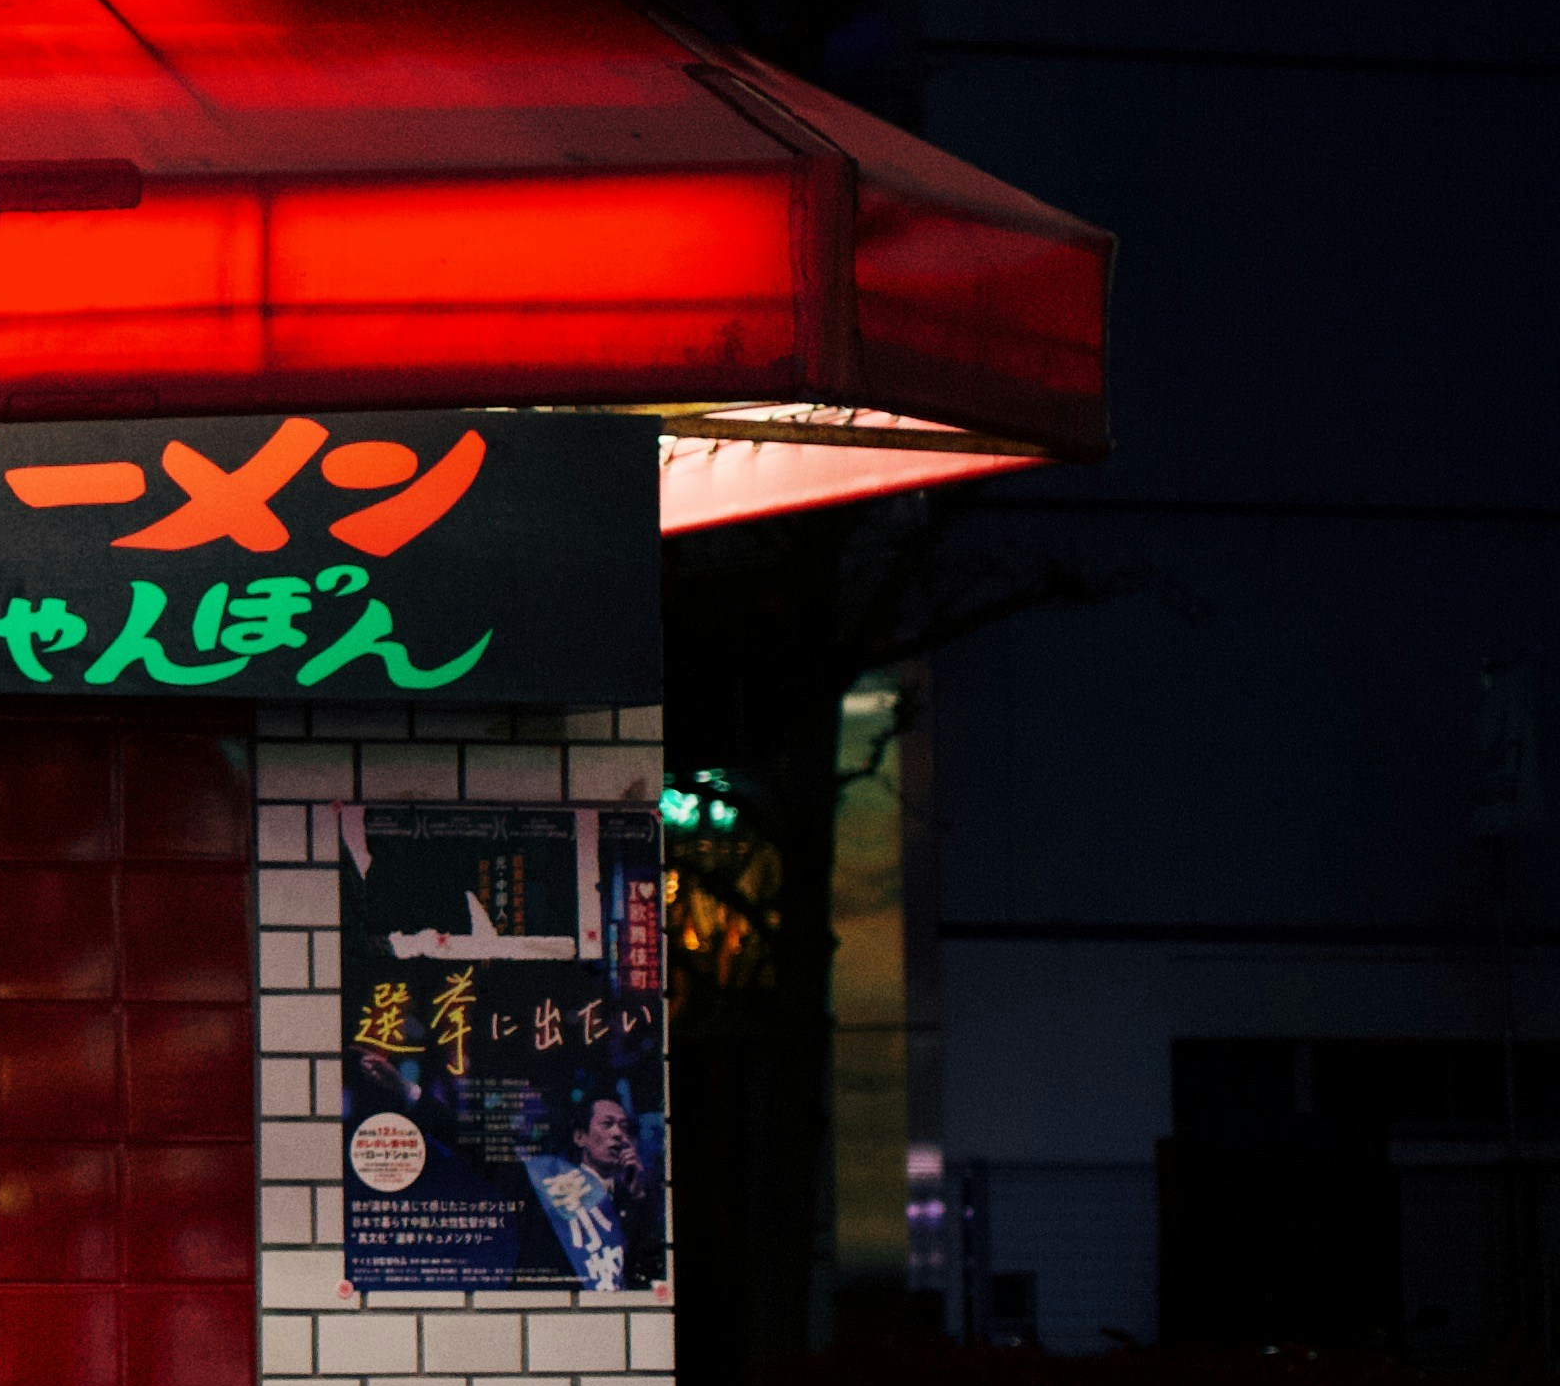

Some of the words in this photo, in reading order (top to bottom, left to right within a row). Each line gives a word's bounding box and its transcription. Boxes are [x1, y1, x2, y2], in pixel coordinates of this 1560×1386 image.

[353, 966, 654, 1076] 選挙に出たい
